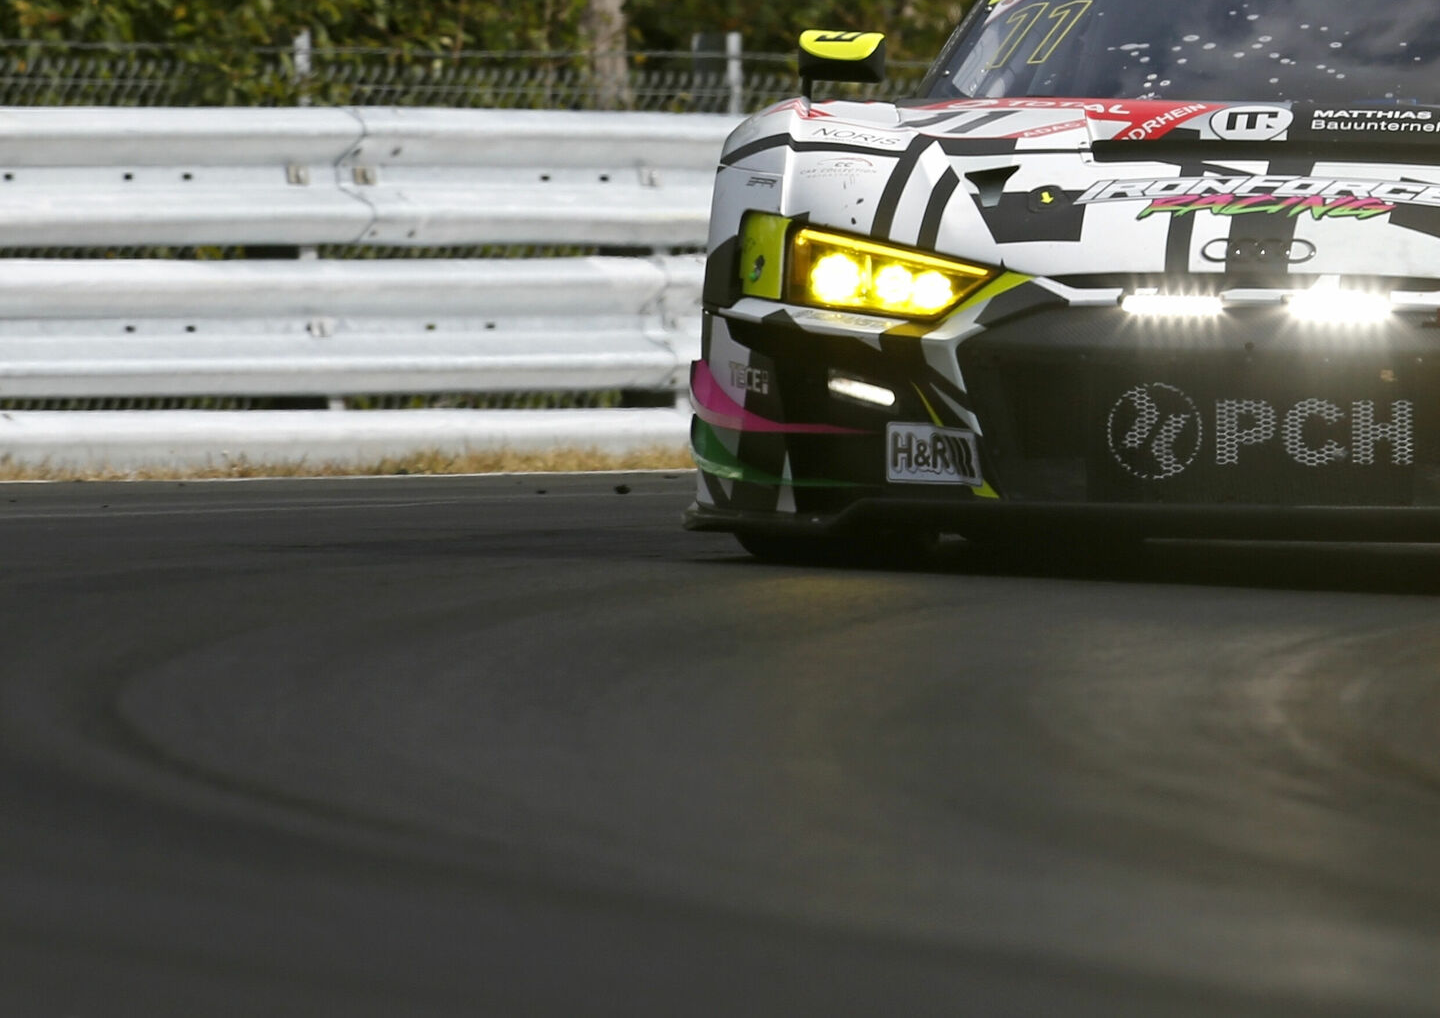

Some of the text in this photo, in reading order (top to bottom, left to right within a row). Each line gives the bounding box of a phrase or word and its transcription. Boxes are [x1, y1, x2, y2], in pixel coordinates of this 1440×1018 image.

[985, 0, 1093, 70] 11
[1008, 100, 1131, 114] TOTAL
[1121, 103, 1208, 140] DRHEIN
[1313, 109, 1433, 120] MATTHIAS
[811, 127, 901, 146] NORIS
[1136, 193, 1397, 220] RACING
[1215, 397, 1414, 467] PCH
[892, 432, 951, 471] H&R
